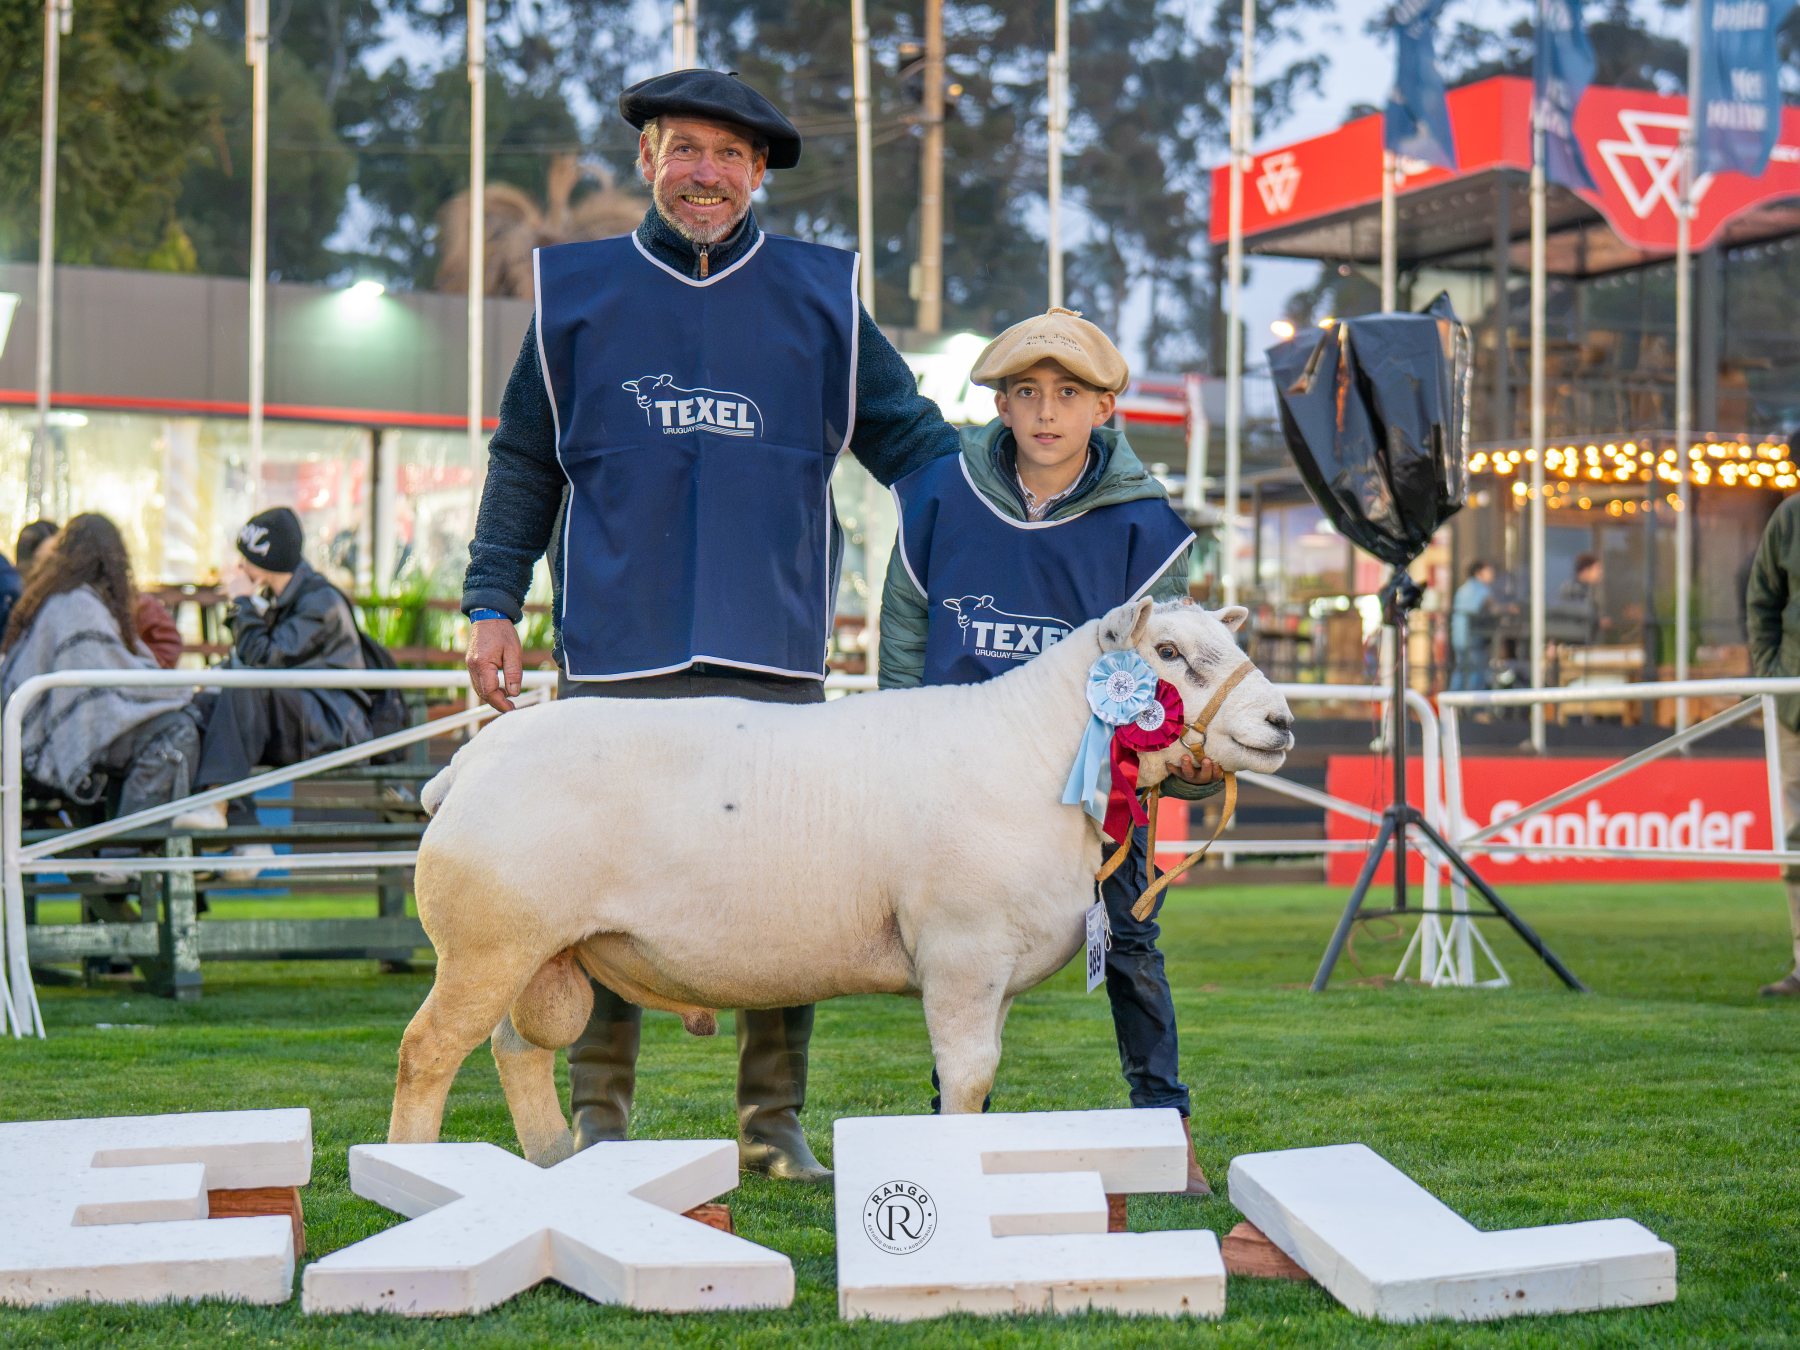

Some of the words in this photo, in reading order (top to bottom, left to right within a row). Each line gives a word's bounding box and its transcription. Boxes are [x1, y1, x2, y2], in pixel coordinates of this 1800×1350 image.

[655, 396, 755, 429] TEXEL
[662, 424, 696, 435] URUGUAY
[971, 621, 1069, 653] TEXE
[975, 649, 1012, 659] URUGUAY
[1489, 798, 1755, 864] Santander
